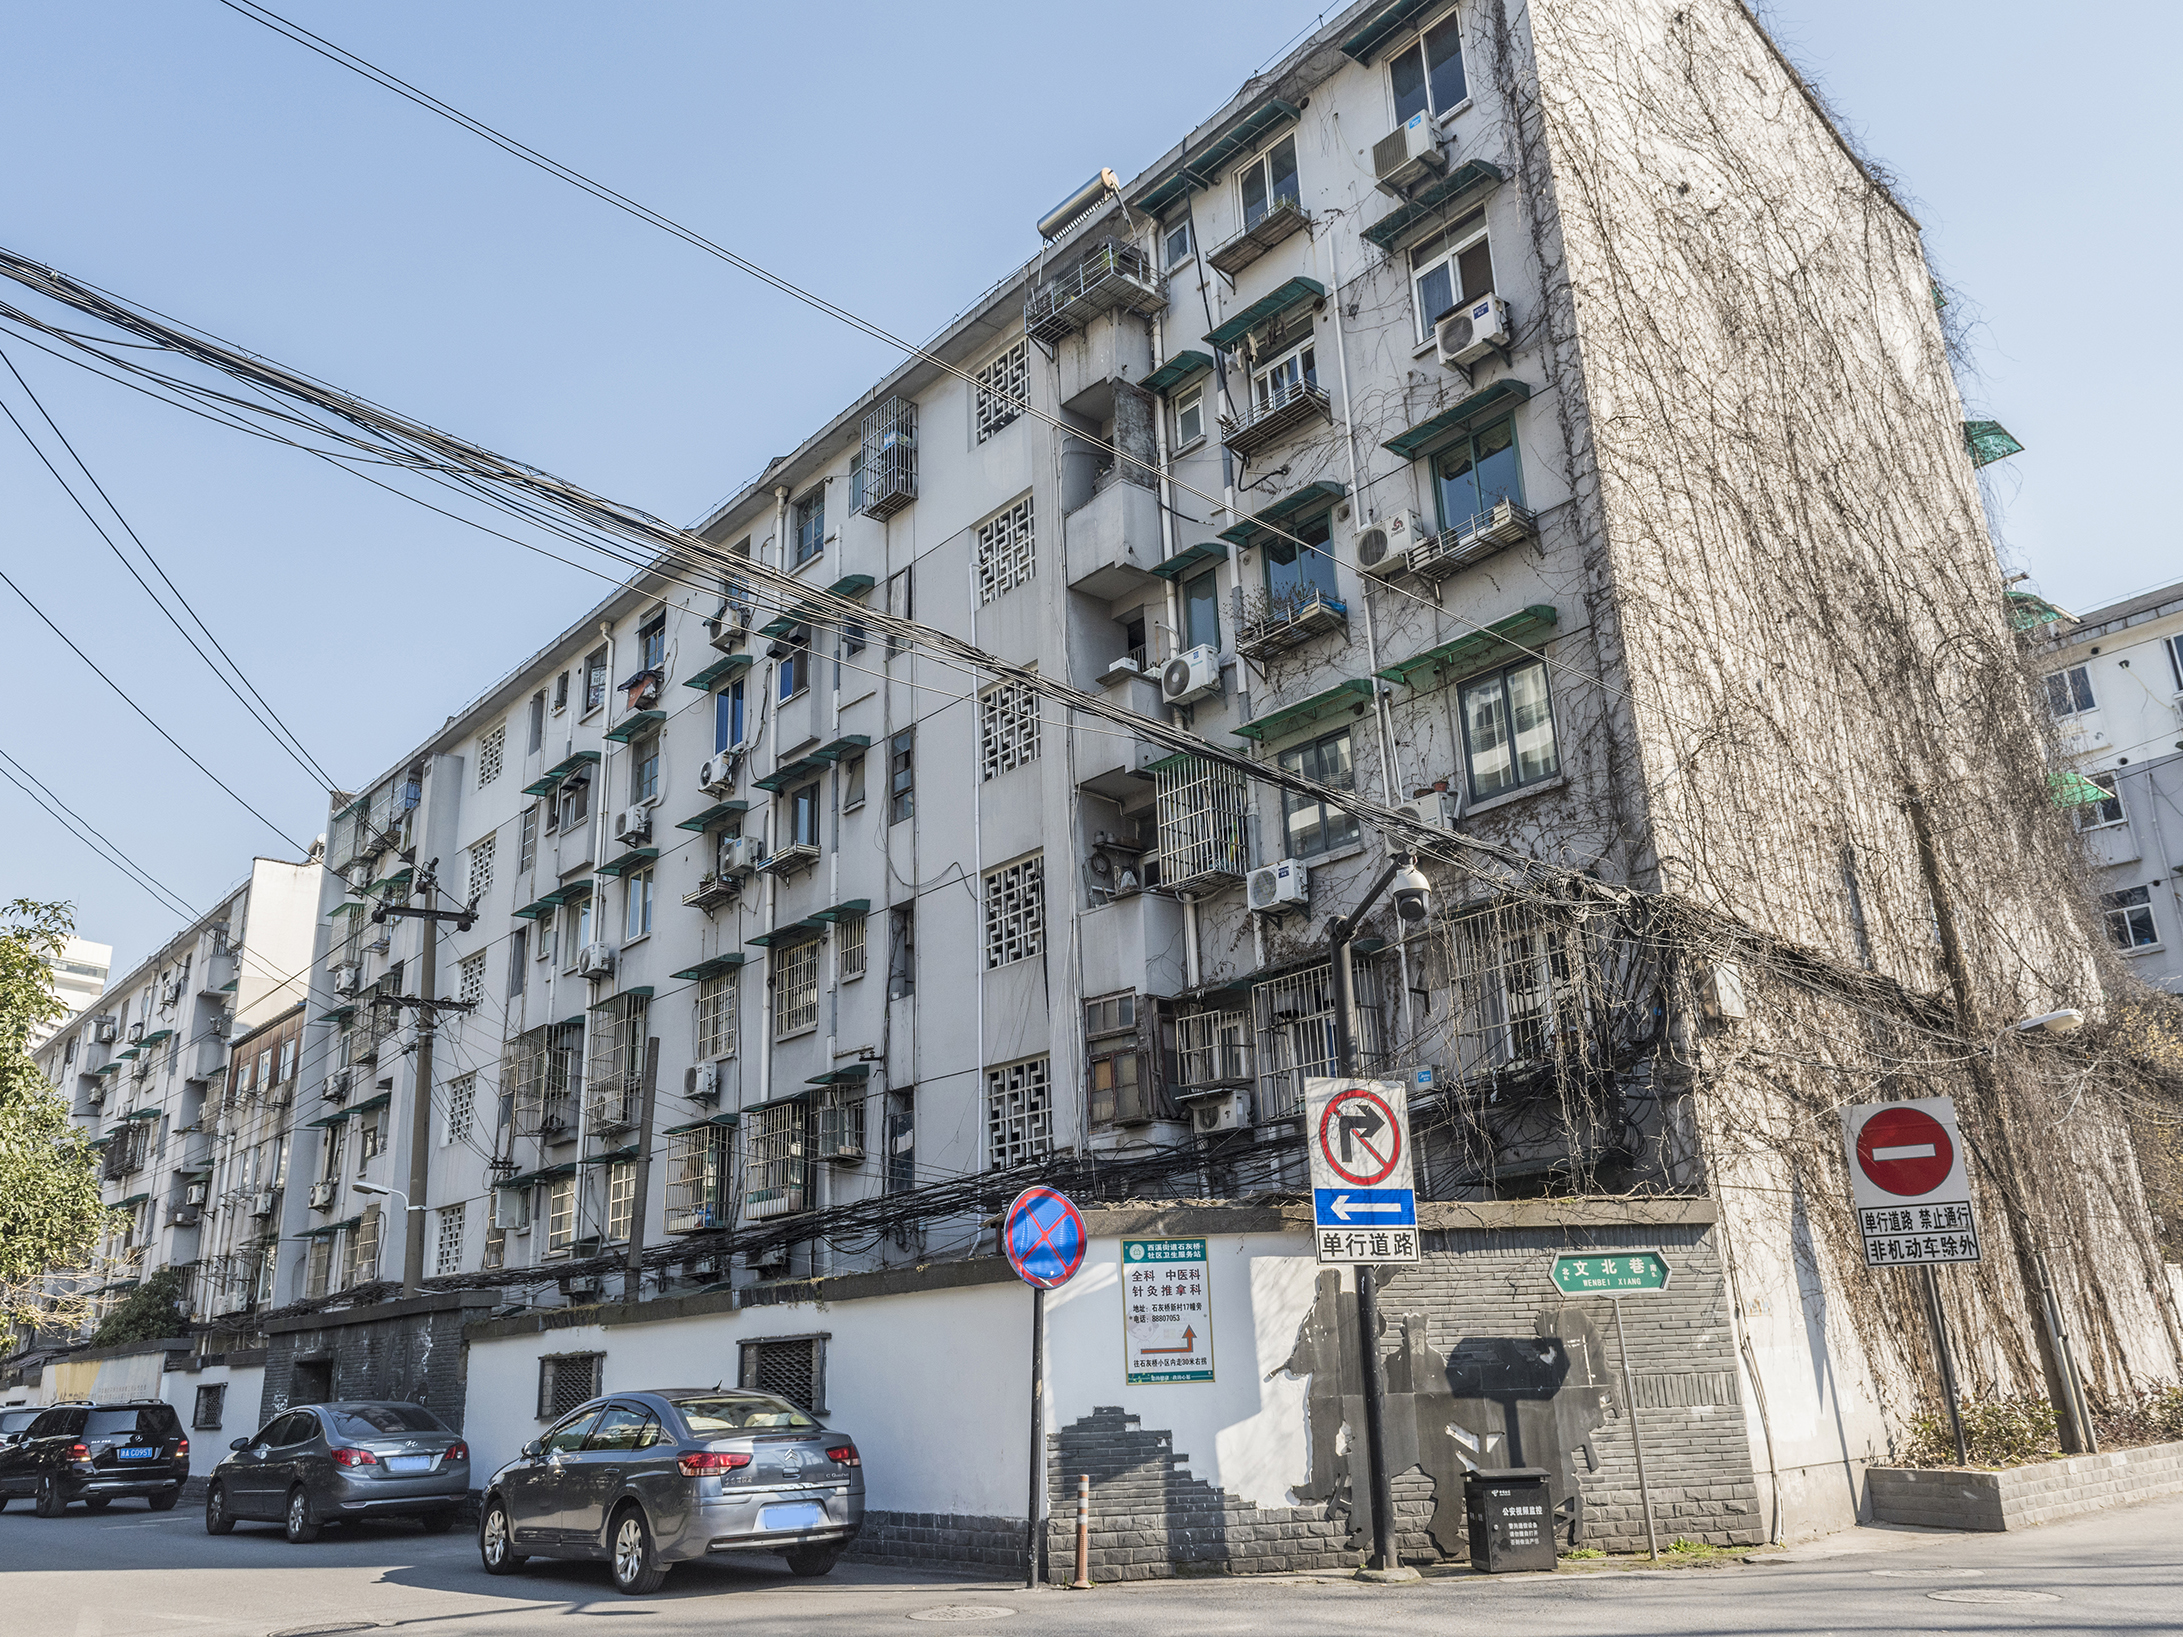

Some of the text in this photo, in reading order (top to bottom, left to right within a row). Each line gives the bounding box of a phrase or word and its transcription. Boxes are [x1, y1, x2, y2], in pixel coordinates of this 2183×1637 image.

[1865, 1206, 1970, 1234] 单行道路 禁止通行
[1147, 1242, 1201, 1252] 西溪街道石灰桥
[1322, 1232, 1414, 1257] 单行道路
[1870, 1235, 1976, 1261] 非机动车除外
[1147, 1251, 1202, 1259] 社区卫生服务站
[1562, 1267, 1570, 1275] 北
[1573, 1258, 1645, 1276] 文北巷
[1132, 1268, 1201, 1282] 全科 中医科
[1583, 1277, 1642, 1287] WENBEI XIANG
[1132, 1284, 1202, 1297] 针灸推拿科
[1502, 1506, 1542, 1516] 公安视频监控
